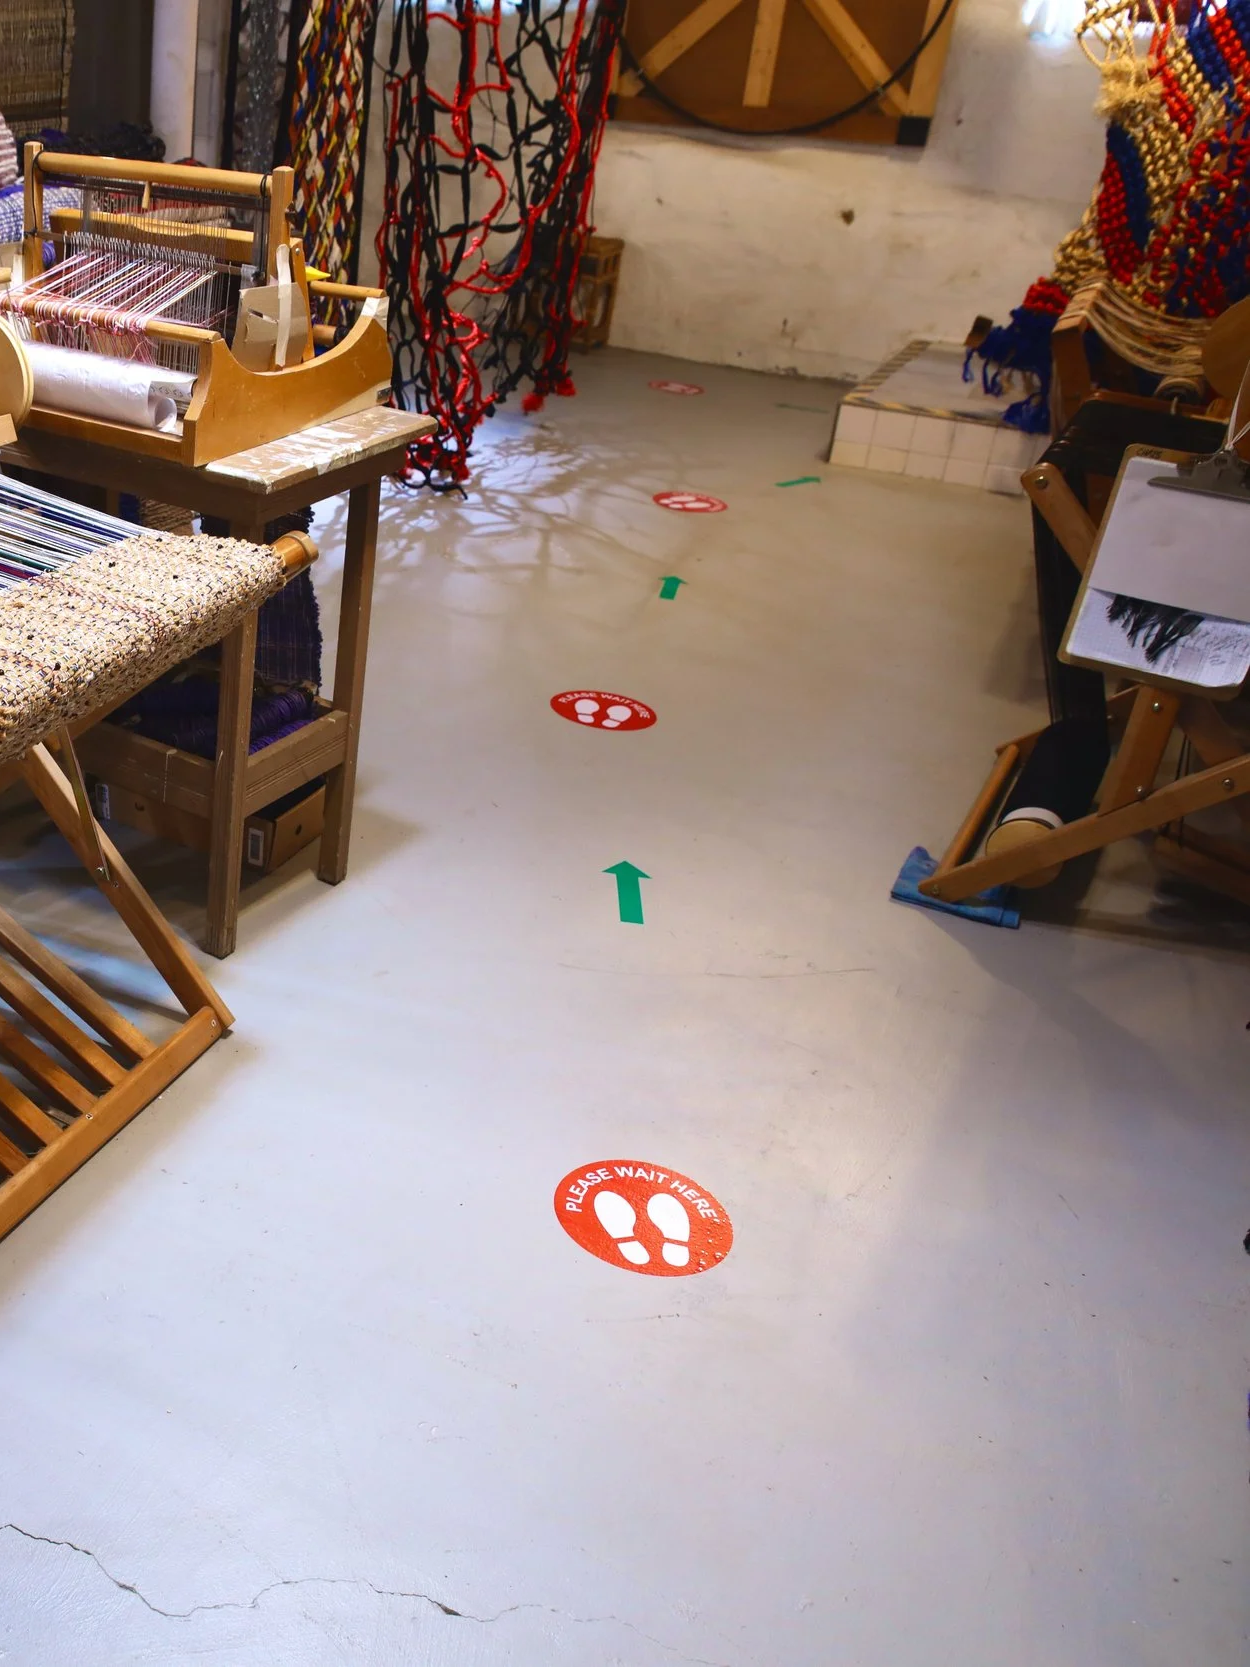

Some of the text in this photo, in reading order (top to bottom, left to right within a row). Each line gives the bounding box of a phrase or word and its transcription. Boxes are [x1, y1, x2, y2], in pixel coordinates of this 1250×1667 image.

[600, 694, 633, 704] WAIT
[566, 1166, 718, 1218] PLEASE WAIT HERE
